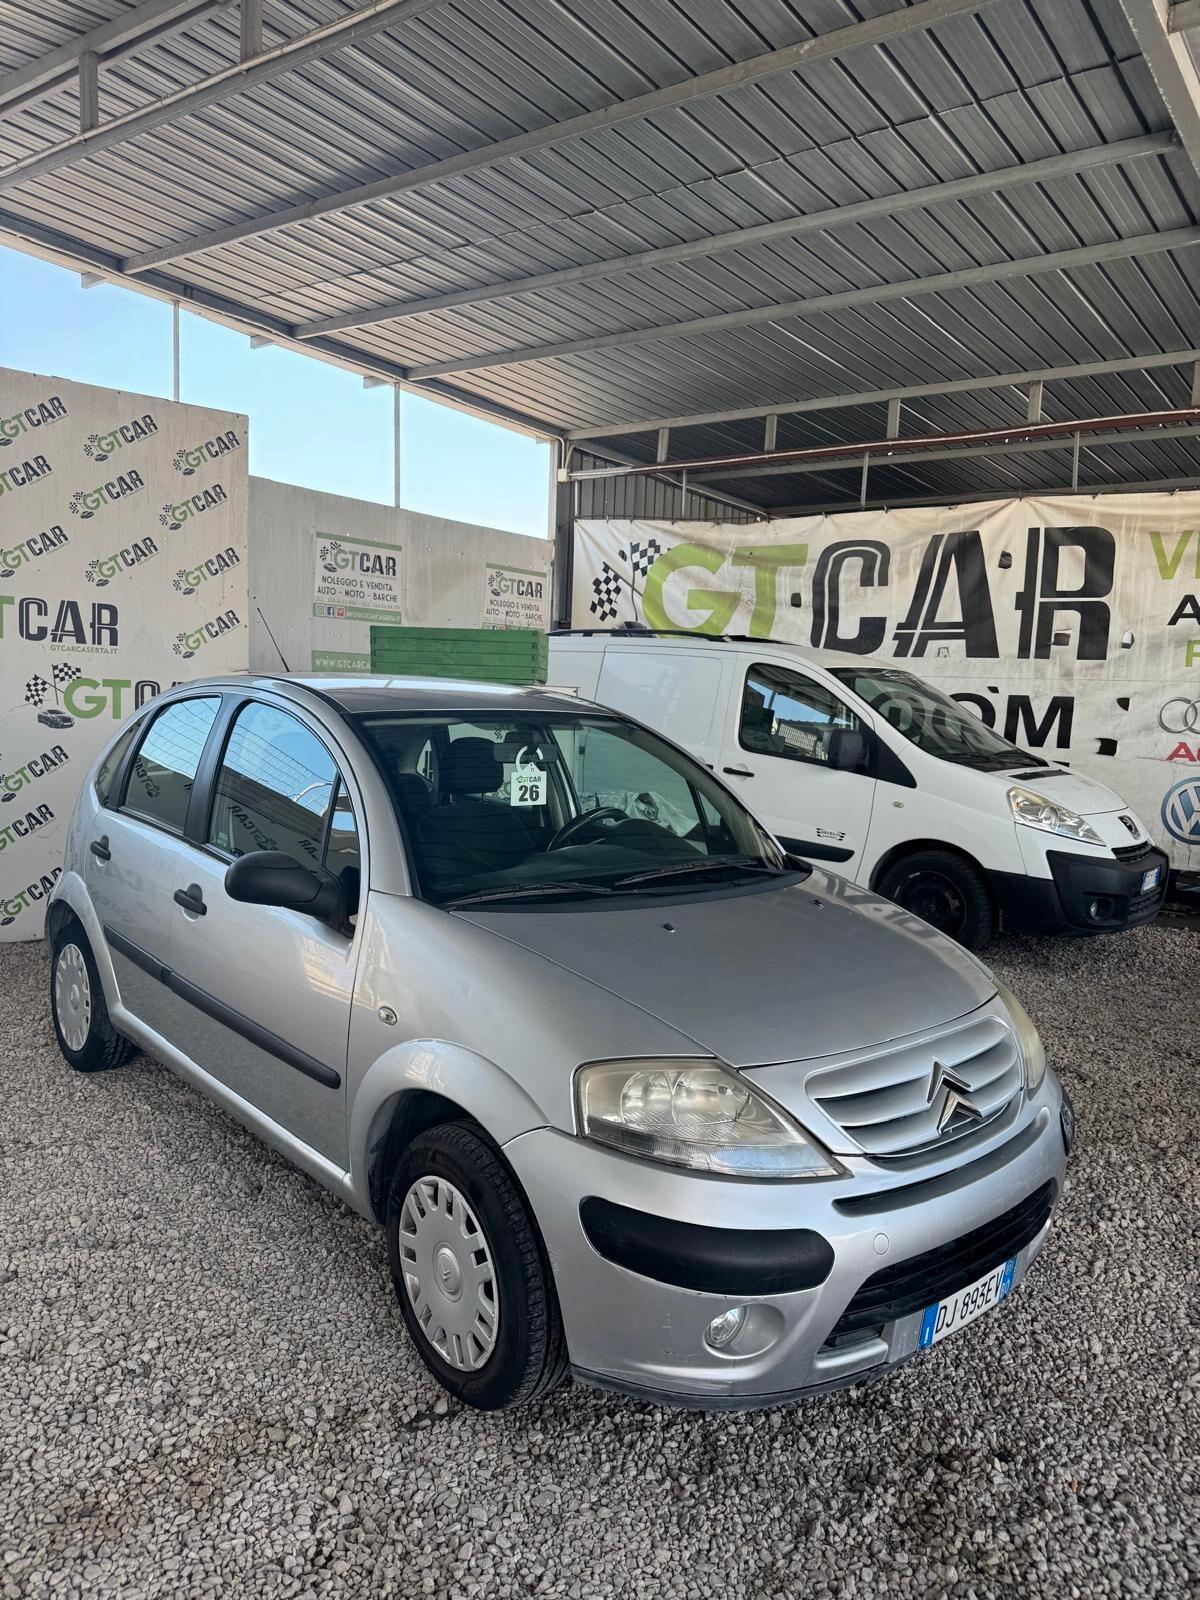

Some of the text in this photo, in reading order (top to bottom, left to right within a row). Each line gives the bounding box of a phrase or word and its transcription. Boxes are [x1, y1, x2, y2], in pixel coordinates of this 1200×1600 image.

[0, 396, 67, 438] GTCAR
[97, 414, 158, 454] GTCAR
[185, 430, 240, 468] GTCAR
[0, 455, 52, 496] TCAR
[82, 469, 144, 511] GTCAR
[171, 483, 228, 523] GTCAR
[2, 525, 69, 569] GTCAR
[98, 536, 159, 579] GTCAR
[334, 549, 396, 576] GTCAR
[1149, 529, 1200, 580] V
[184, 547, 240, 588] GTCAR
[322, 576, 358, 588] NOLEGGIO
[360, 580, 364, 588] E
[366, 581, 393, 592] VENDITA
[499, 576, 543, 599] GTCAR
[317, 586, 336, 596] AUTO
[344, 589, 365, 599] MOTO
[373, 593, 397, 602] BARCHE
[486, 608, 500, 616] AUTO
[490, 599, 516, 609] NOLEGGIO
[521, 603, 540, 611] VENDITA
[642, 527, 1116, 660] GTCAR
[50, 644, 119, 656] GTCARCASERTA.IT
[184, 609, 241, 652] GTCAR
[63, 678, 184, 720] GTC
[4, 745, 69, 792] GTCAR
[1166, 741, 1200, 762] A
[518, 784, 540, 803] 26
[935, 1299, 958, 1335] DJ
[961, 1269, 1004, 1321] 893EV
